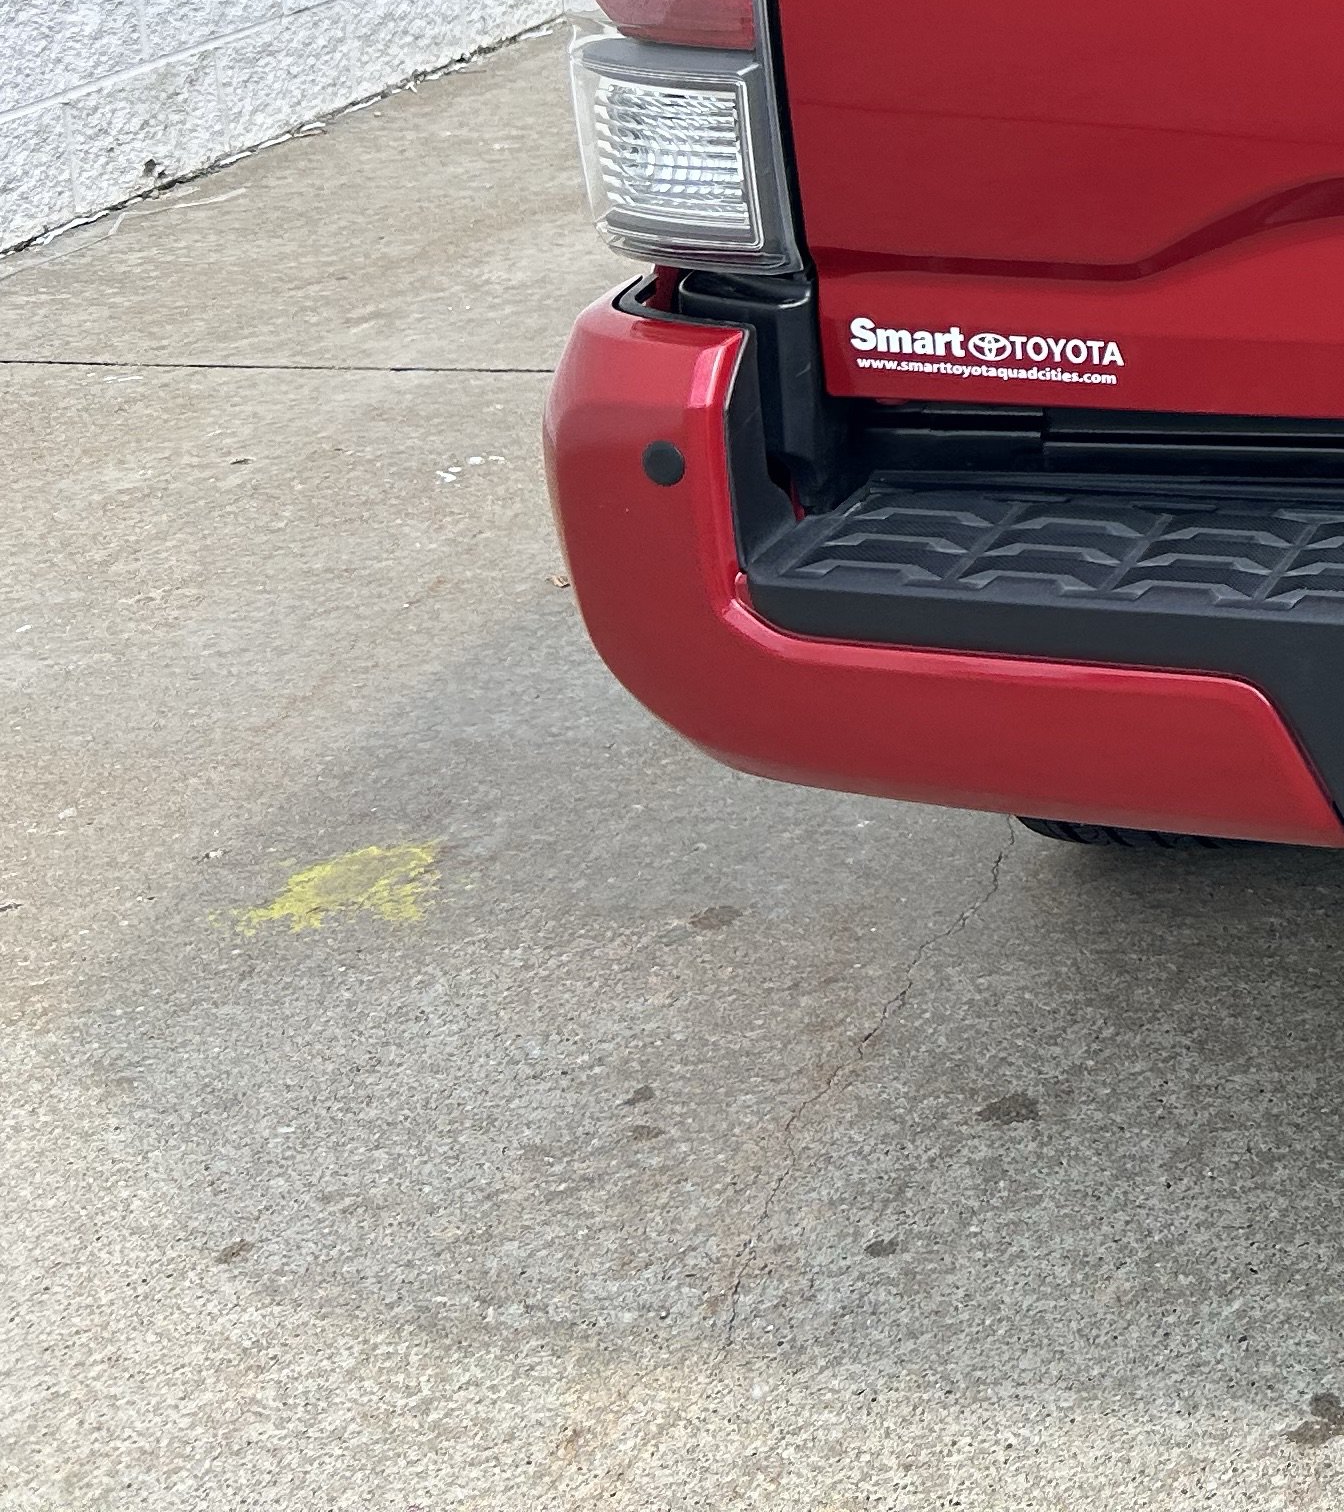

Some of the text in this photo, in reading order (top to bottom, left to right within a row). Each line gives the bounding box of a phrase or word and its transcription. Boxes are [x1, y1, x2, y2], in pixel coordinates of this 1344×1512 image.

[850, 317, 1125, 367] Smart TOYOTA
[857, 356, 1117, 385] www.smarttoyotaquadcities.com
